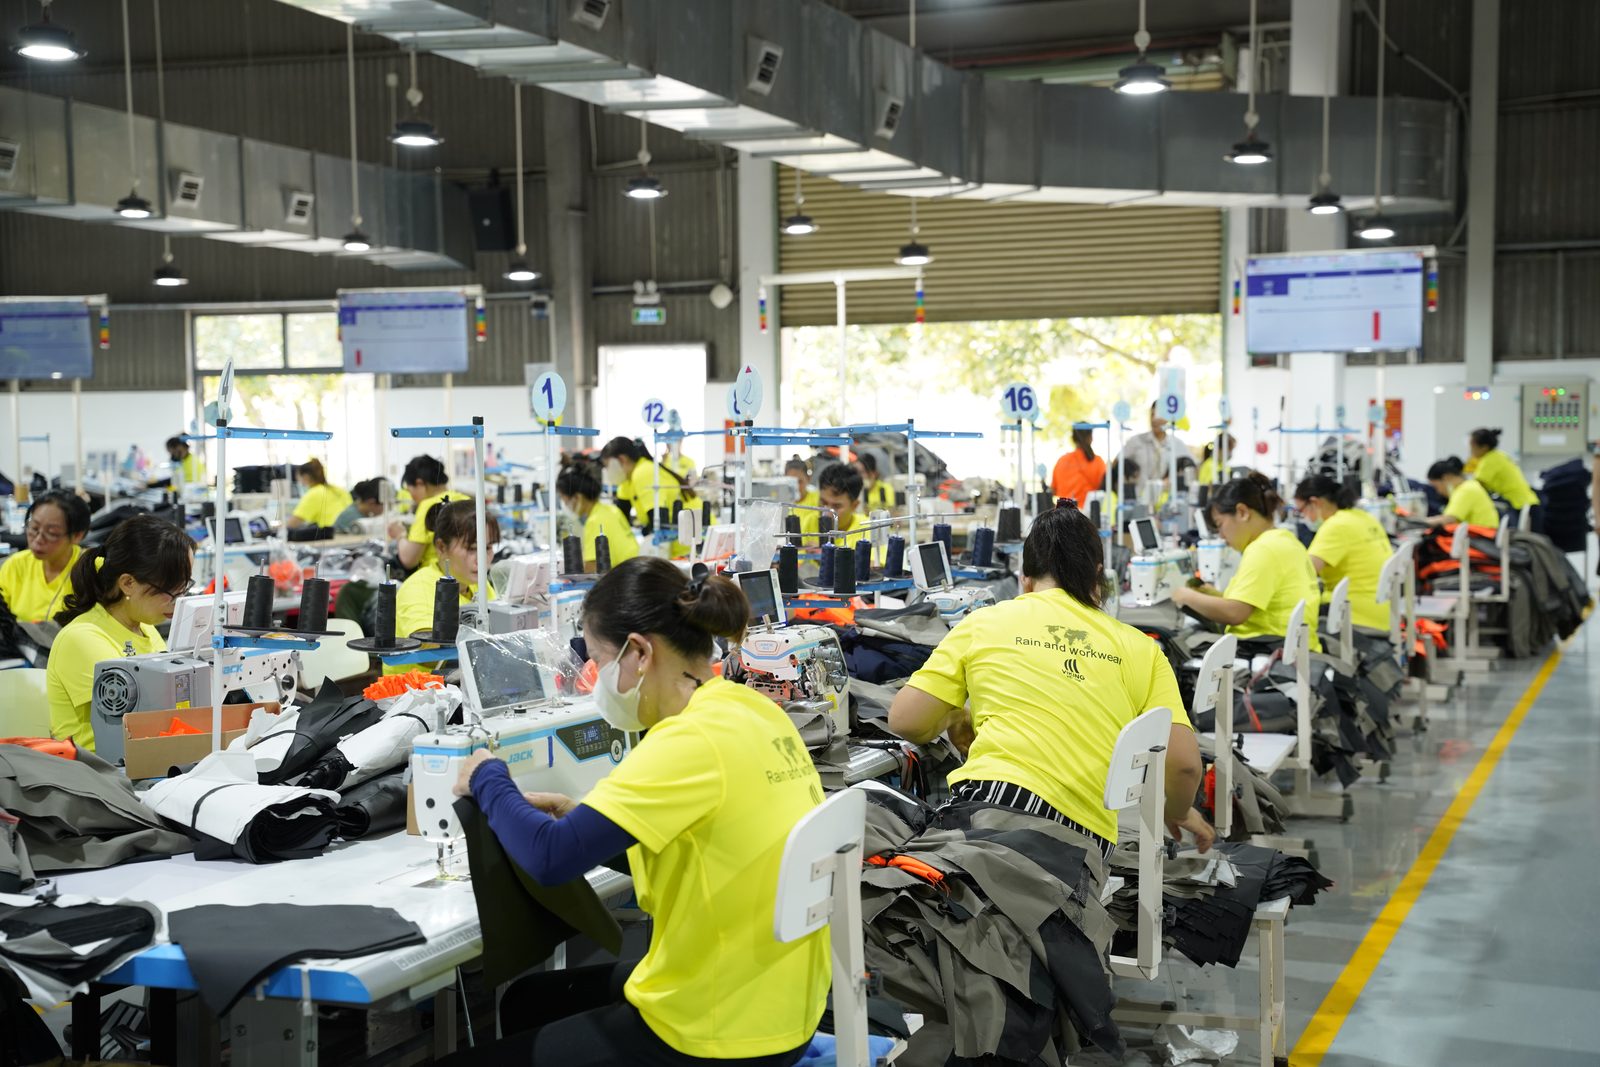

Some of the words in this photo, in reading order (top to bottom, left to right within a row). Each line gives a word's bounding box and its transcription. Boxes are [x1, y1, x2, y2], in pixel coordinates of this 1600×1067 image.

[221, 361, 232, 403] 4
[541, 377, 554, 409] 1
[1004, 386, 1033, 412] 16
[644, 402, 664, 422] 12
[1166, 395, 1179, 414] 9
[1015, 636, 1041, 647] Rain
[1044, 640, 1066, 653] and
[1061, 668, 1086, 681] VIKING
[508, 749, 534, 764] JACK
